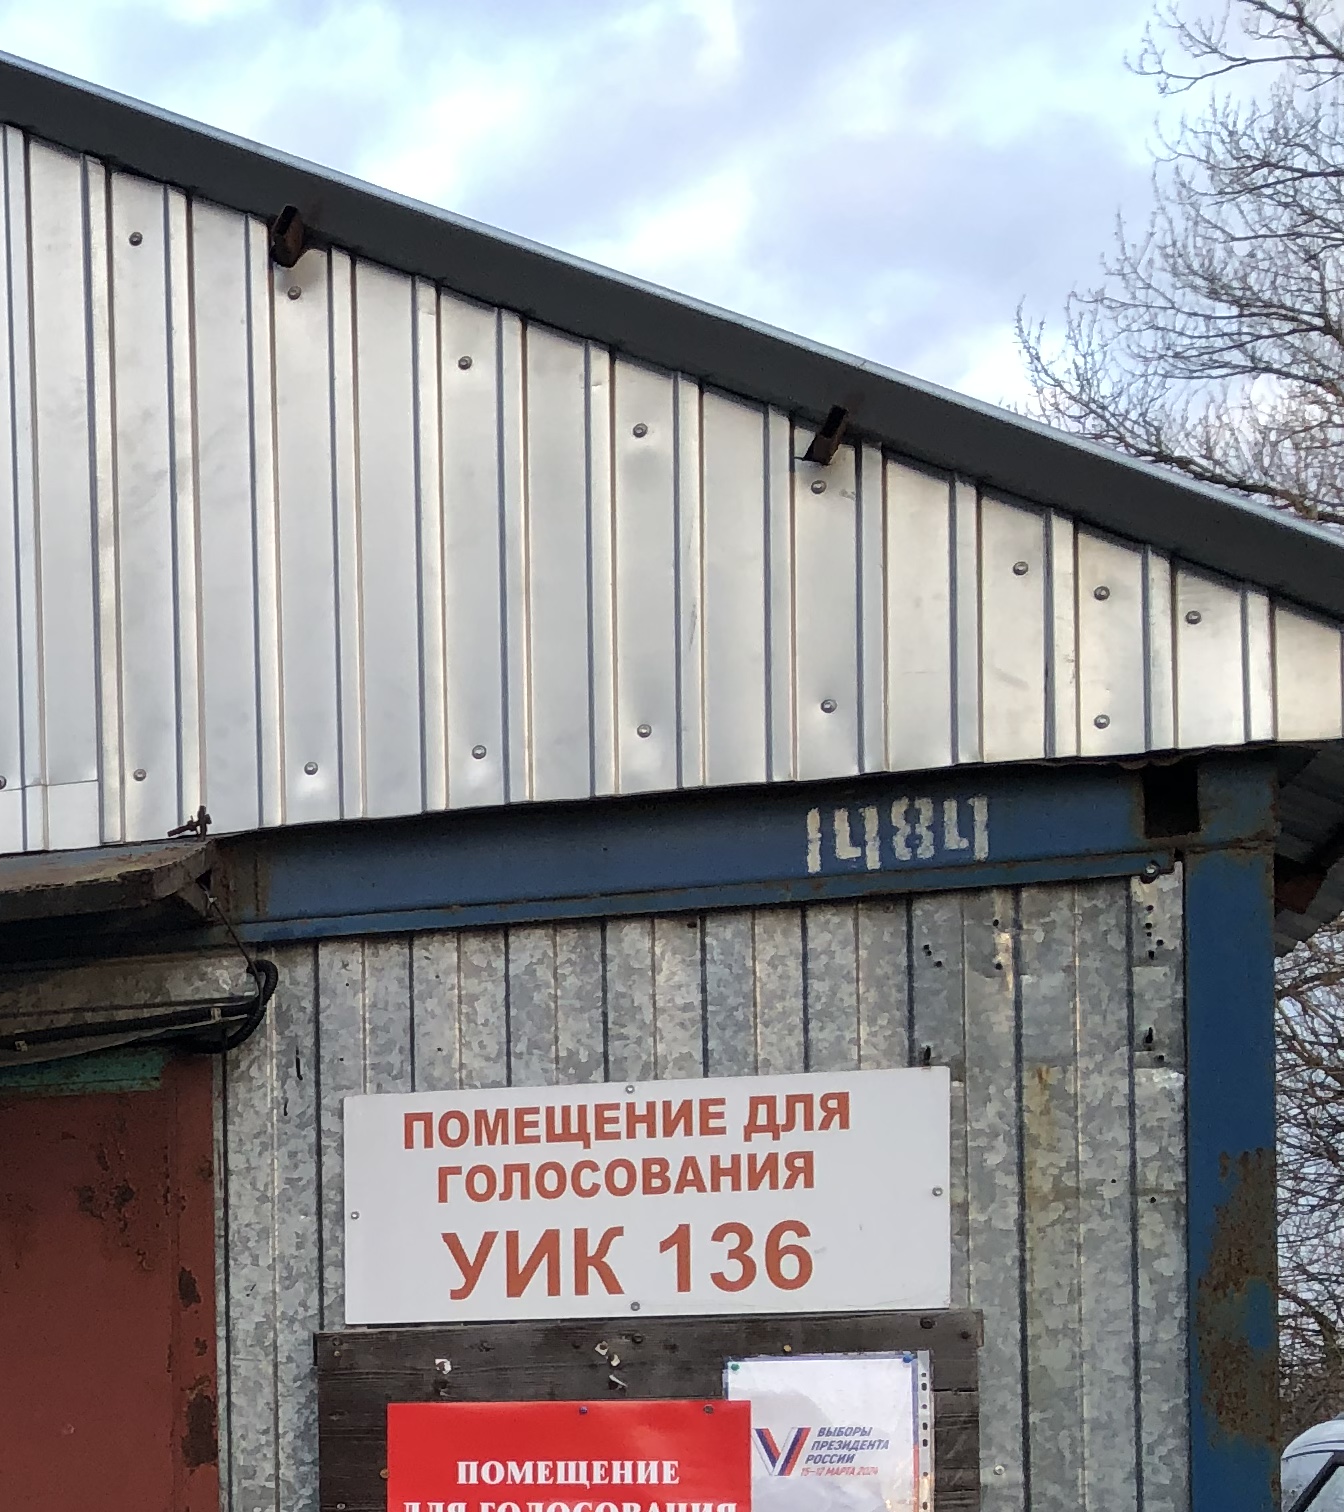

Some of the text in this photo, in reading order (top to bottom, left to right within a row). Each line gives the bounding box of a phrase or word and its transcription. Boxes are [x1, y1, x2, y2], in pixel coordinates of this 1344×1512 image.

[806, 794, 990, 875] 1484
[403, 1091, 851, 1150] ПОМЕЩЕНИЕ ДЛЯ
[437, 1150, 815, 1204] ГОЛОСОВАНИЯ
[441, 1219, 814, 1300] УИК 136
[811, 1438, 890, 1452] ПРЕЗИДЕНТА
[817, 1427, 873, 1438] ВЫБОРЫ
[805, 1453, 856, 1465] РОССИИ
[826, 1466, 855, 1477] МАРТА
[456, 1460, 680, 1490] ПОМЕЩЕНИЕ
